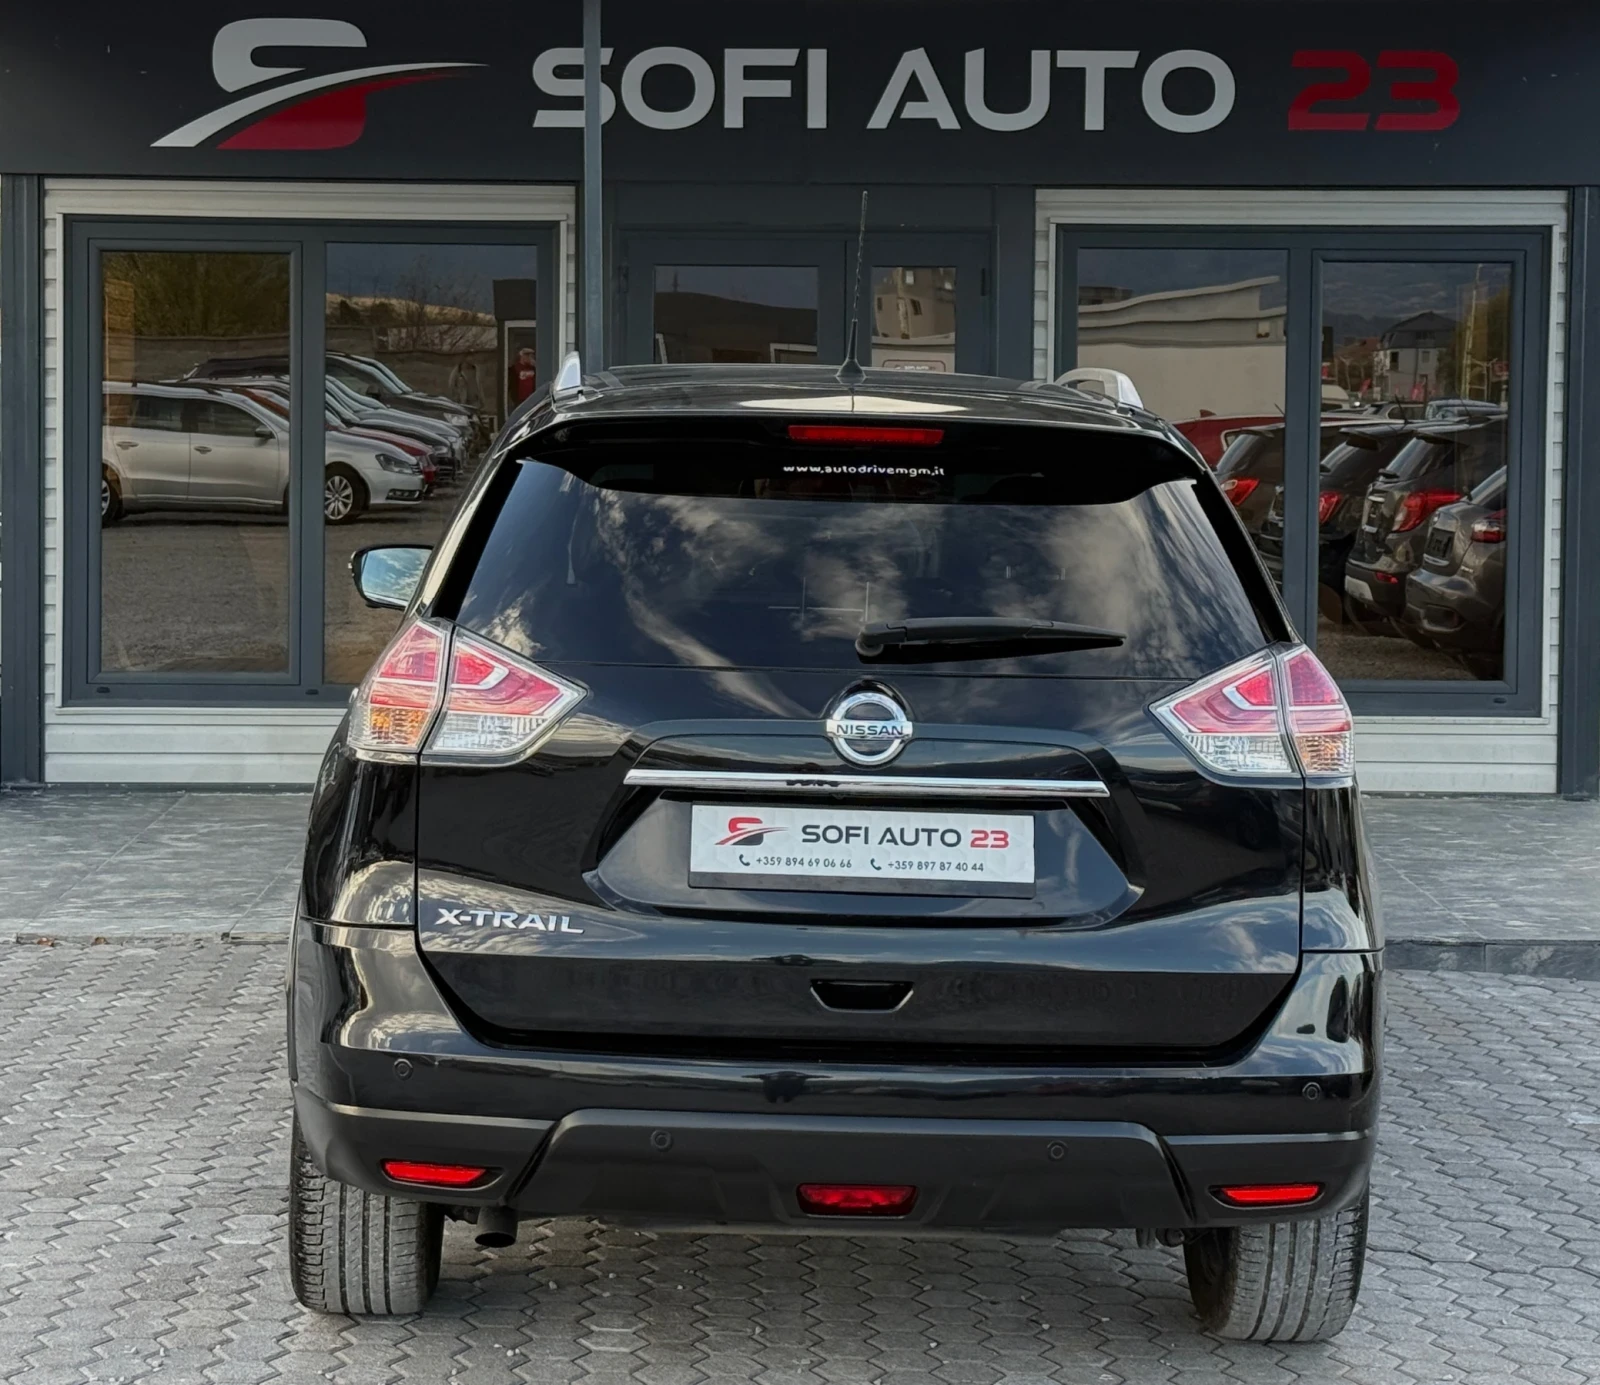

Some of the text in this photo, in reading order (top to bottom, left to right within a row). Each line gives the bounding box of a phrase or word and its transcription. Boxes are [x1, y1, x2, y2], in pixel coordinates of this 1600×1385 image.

[532, 46, 1460, 133] SOFI AUTO 23
[783, 465, 945, 477] www.autodrivemgm.it
[836, 724, 904, 735] NISSAN
[801, 824, 1010, 849] SOFI AUTO 23
[756, 856, 852, 868] +359 894 69 06 66
[888, 860, 984, 872] +359 897 87 40 44
[434, 908, 584, 934] X-TRAIL
